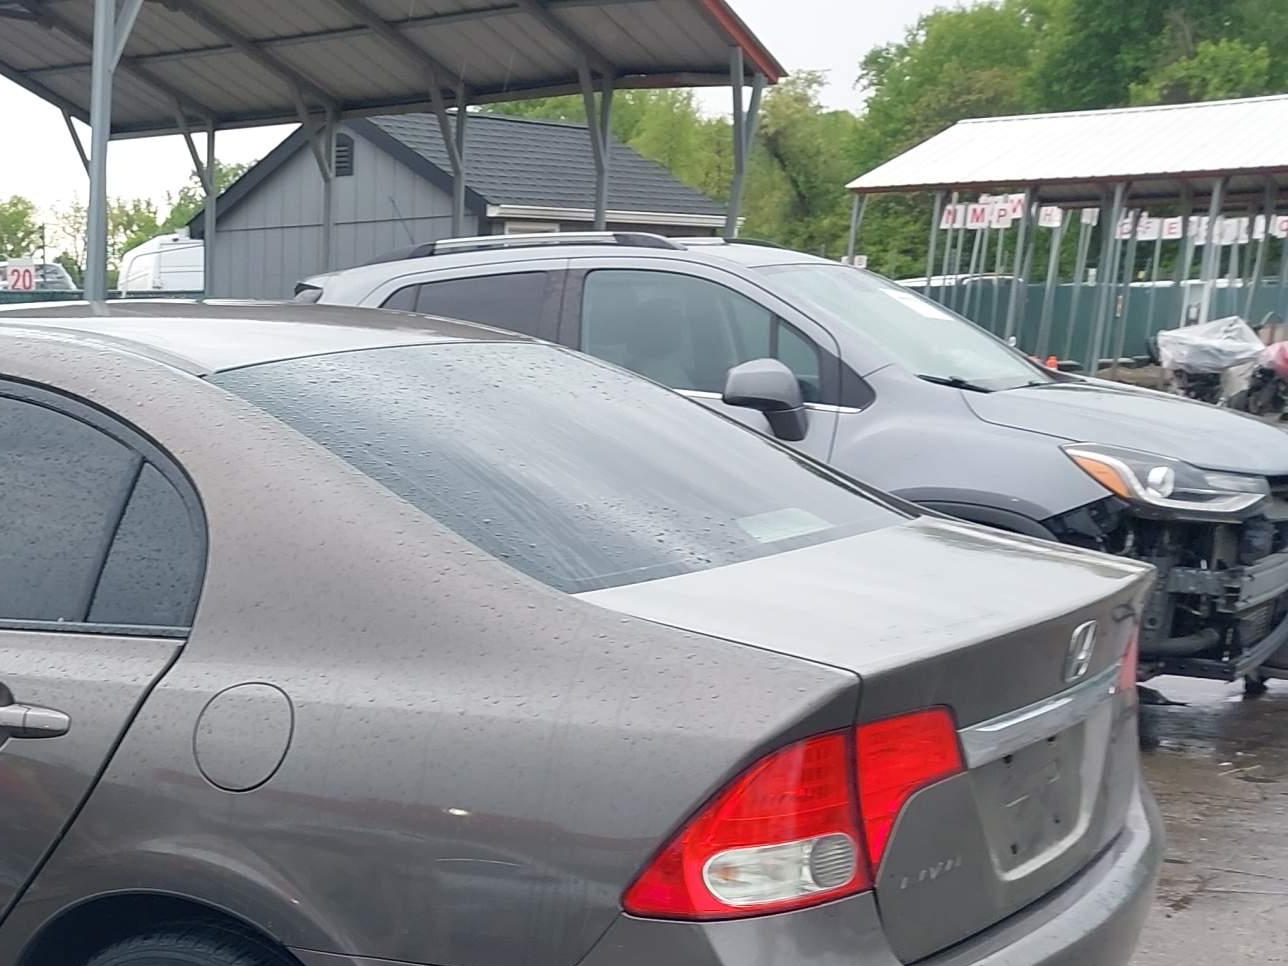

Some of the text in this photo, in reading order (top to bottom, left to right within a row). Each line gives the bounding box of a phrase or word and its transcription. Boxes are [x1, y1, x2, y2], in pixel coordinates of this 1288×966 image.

[971, 207, 986, 224] M
[997, 208, 1007, 223] P
[11, 268, 32, 290] 20
